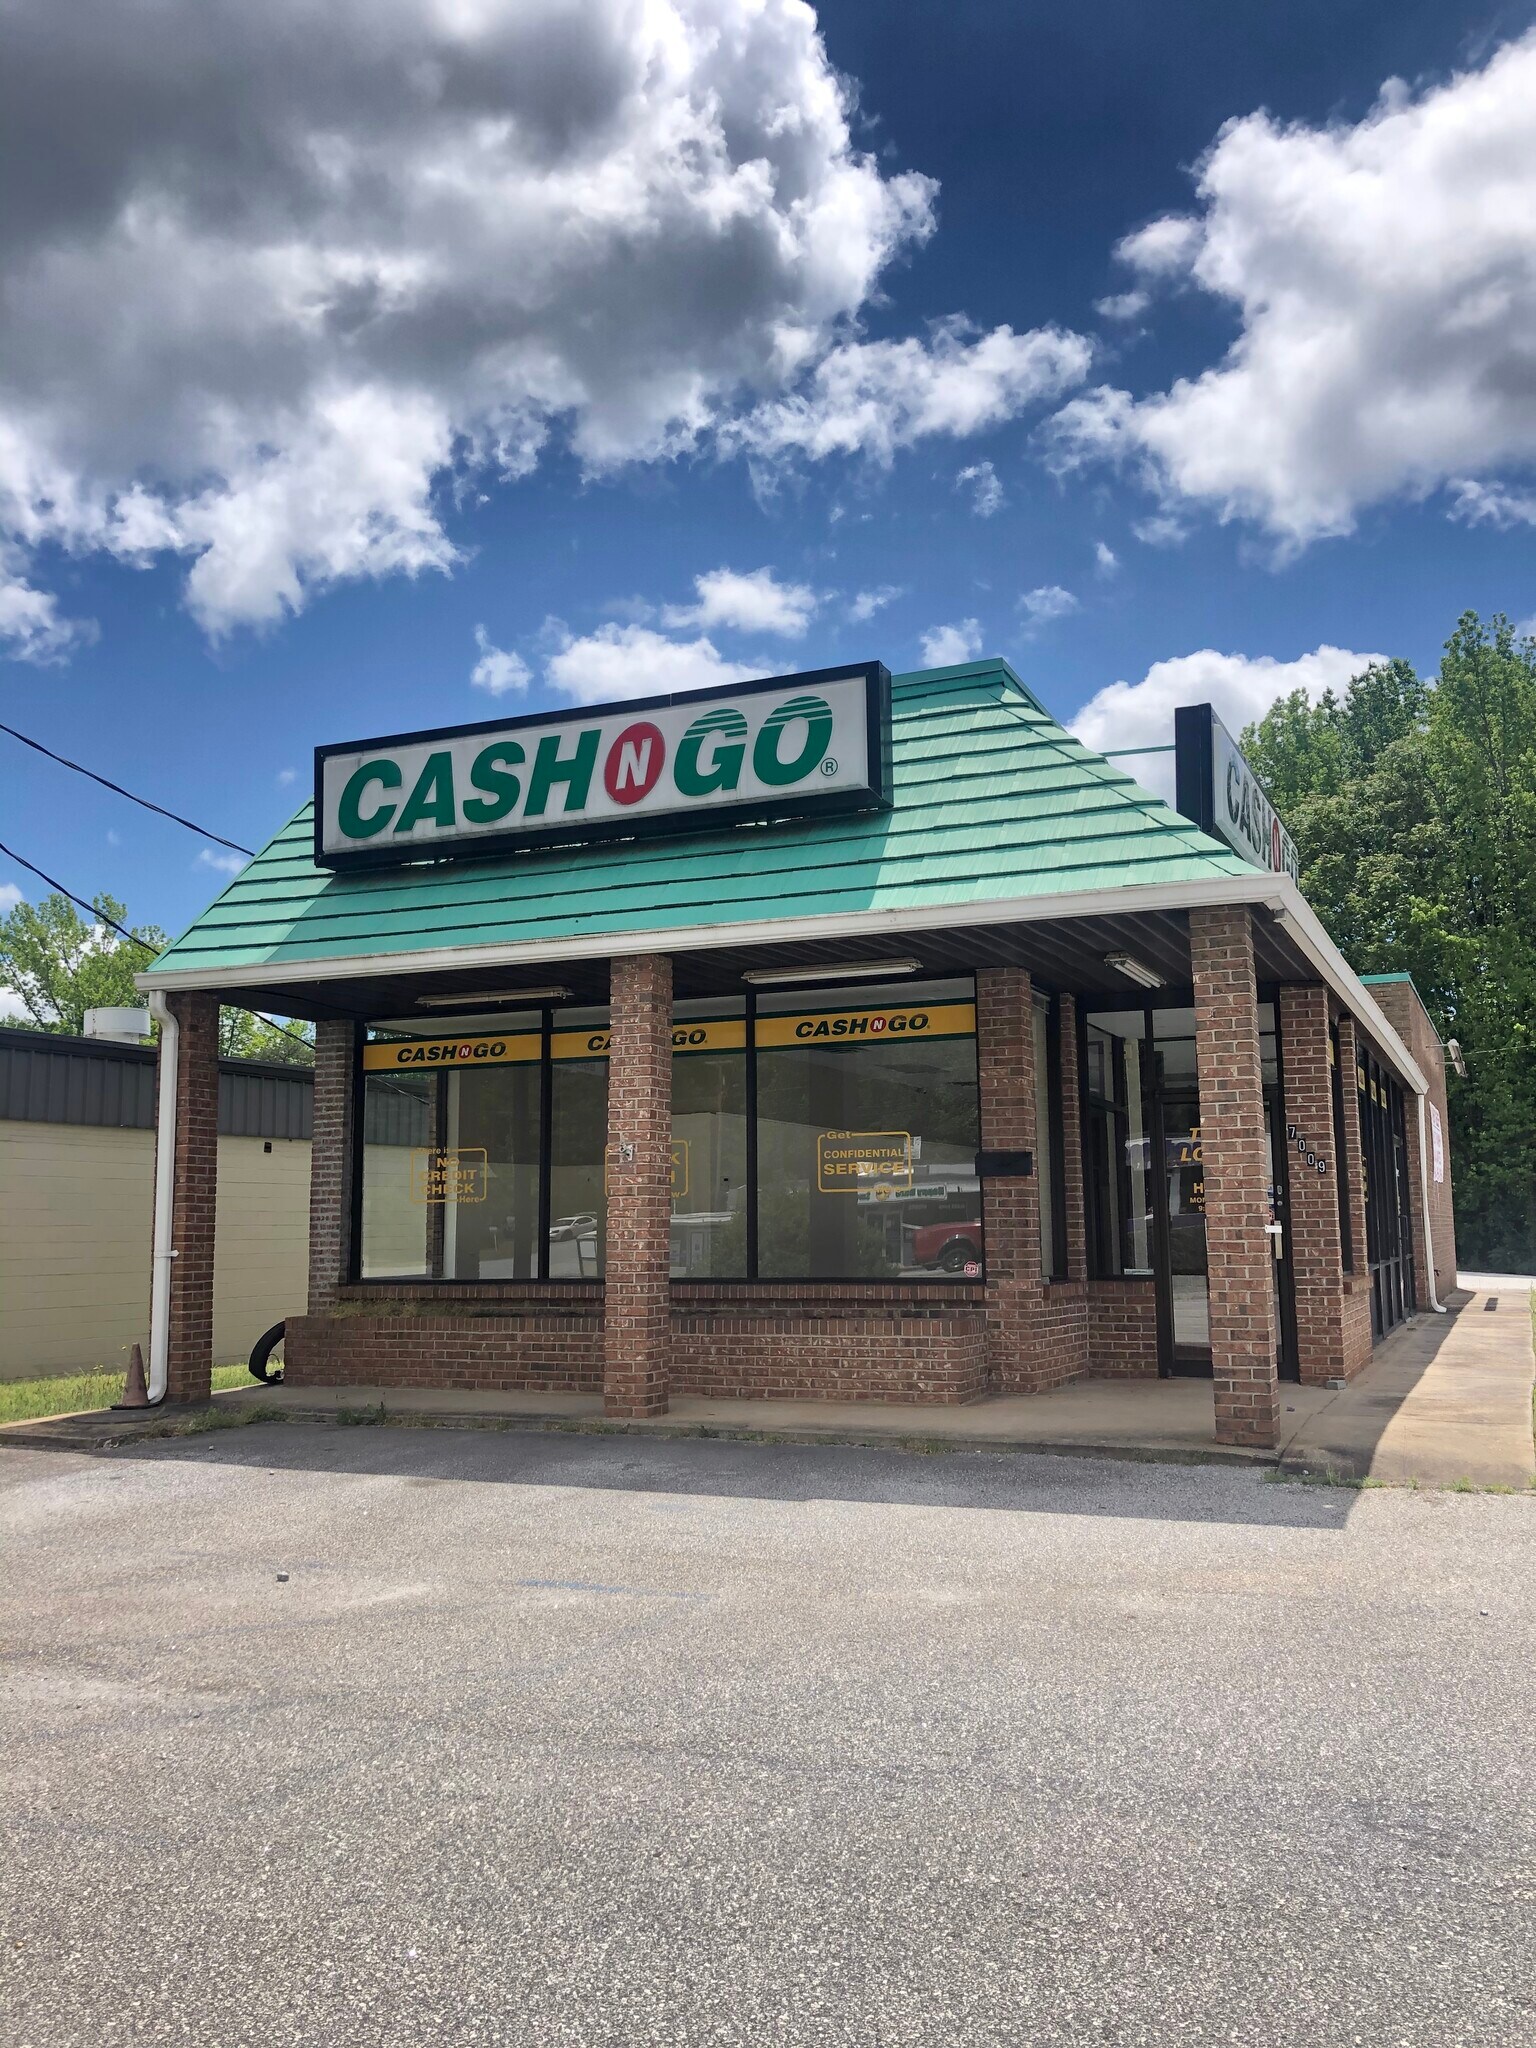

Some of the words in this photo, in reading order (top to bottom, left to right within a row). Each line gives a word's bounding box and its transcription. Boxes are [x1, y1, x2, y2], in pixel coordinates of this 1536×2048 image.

[338, 729, 602, 839] CASH
[1226, 752, 1272, 870] CASH
[795, 1017, 869, 1037] CASH
[397, 1045, 459, 1063] CASH
[827, 1131, 852, 1140] Get
[823, 1148, 905, 1159] CONFIDENTIAL
[1288, 1126, 1325, 1172] 7009
[436, 1157, 460, 1168] NO
[823, 1161, 905, 1176] SERVICE
[418, 1169, 478, 1182] CREDIT
[420, 1182, 475, 1196] CHECK
[458, 1195, 481, 1204] Here
